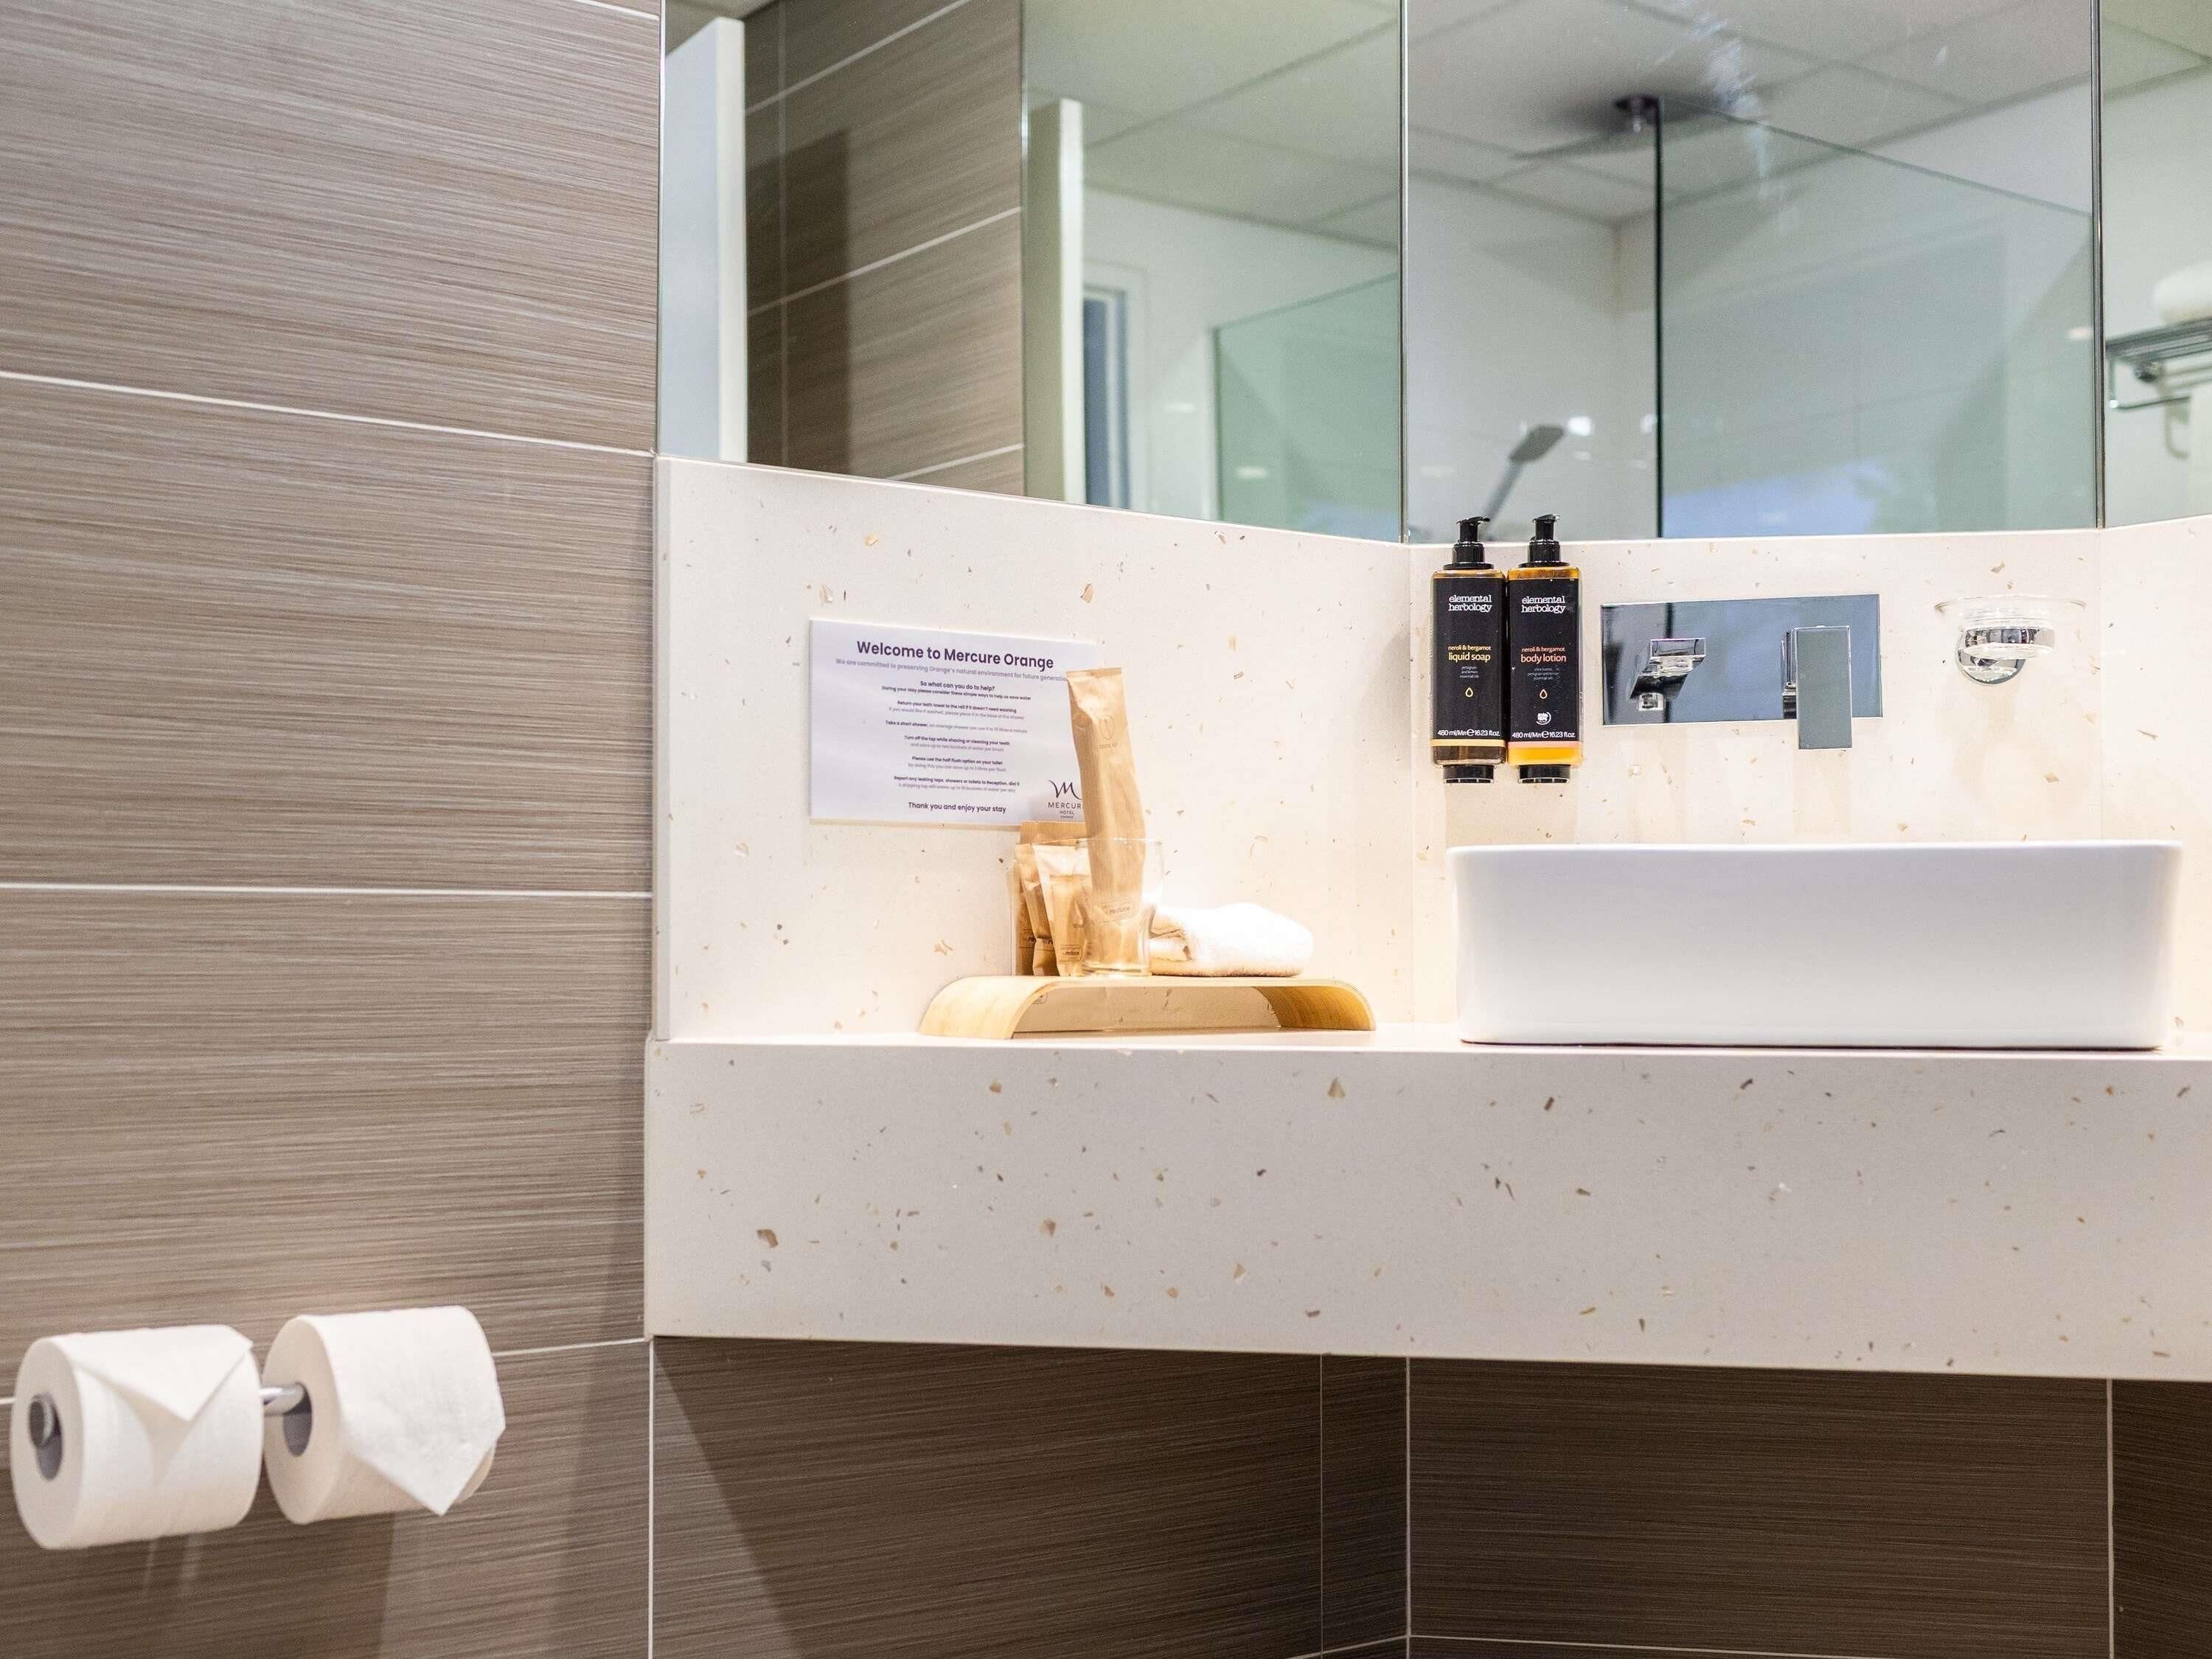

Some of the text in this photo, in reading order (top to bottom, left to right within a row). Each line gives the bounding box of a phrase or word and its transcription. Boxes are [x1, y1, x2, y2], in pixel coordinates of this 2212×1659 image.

[1449, 594, 1492, 602] elemental
[1522, 596, 1565, 604] elemental
[1448, 603, 1492, 613] herbology
[1522, 605, 1566, 613] herbology
[857, 641, 1054, 672] Welcome to Mercure Orange
[1448, 652, 1491, 663] liquid soap
[1521, 653, 1566, 664] body lotion
[958, 804, 975, 813] enjoy
